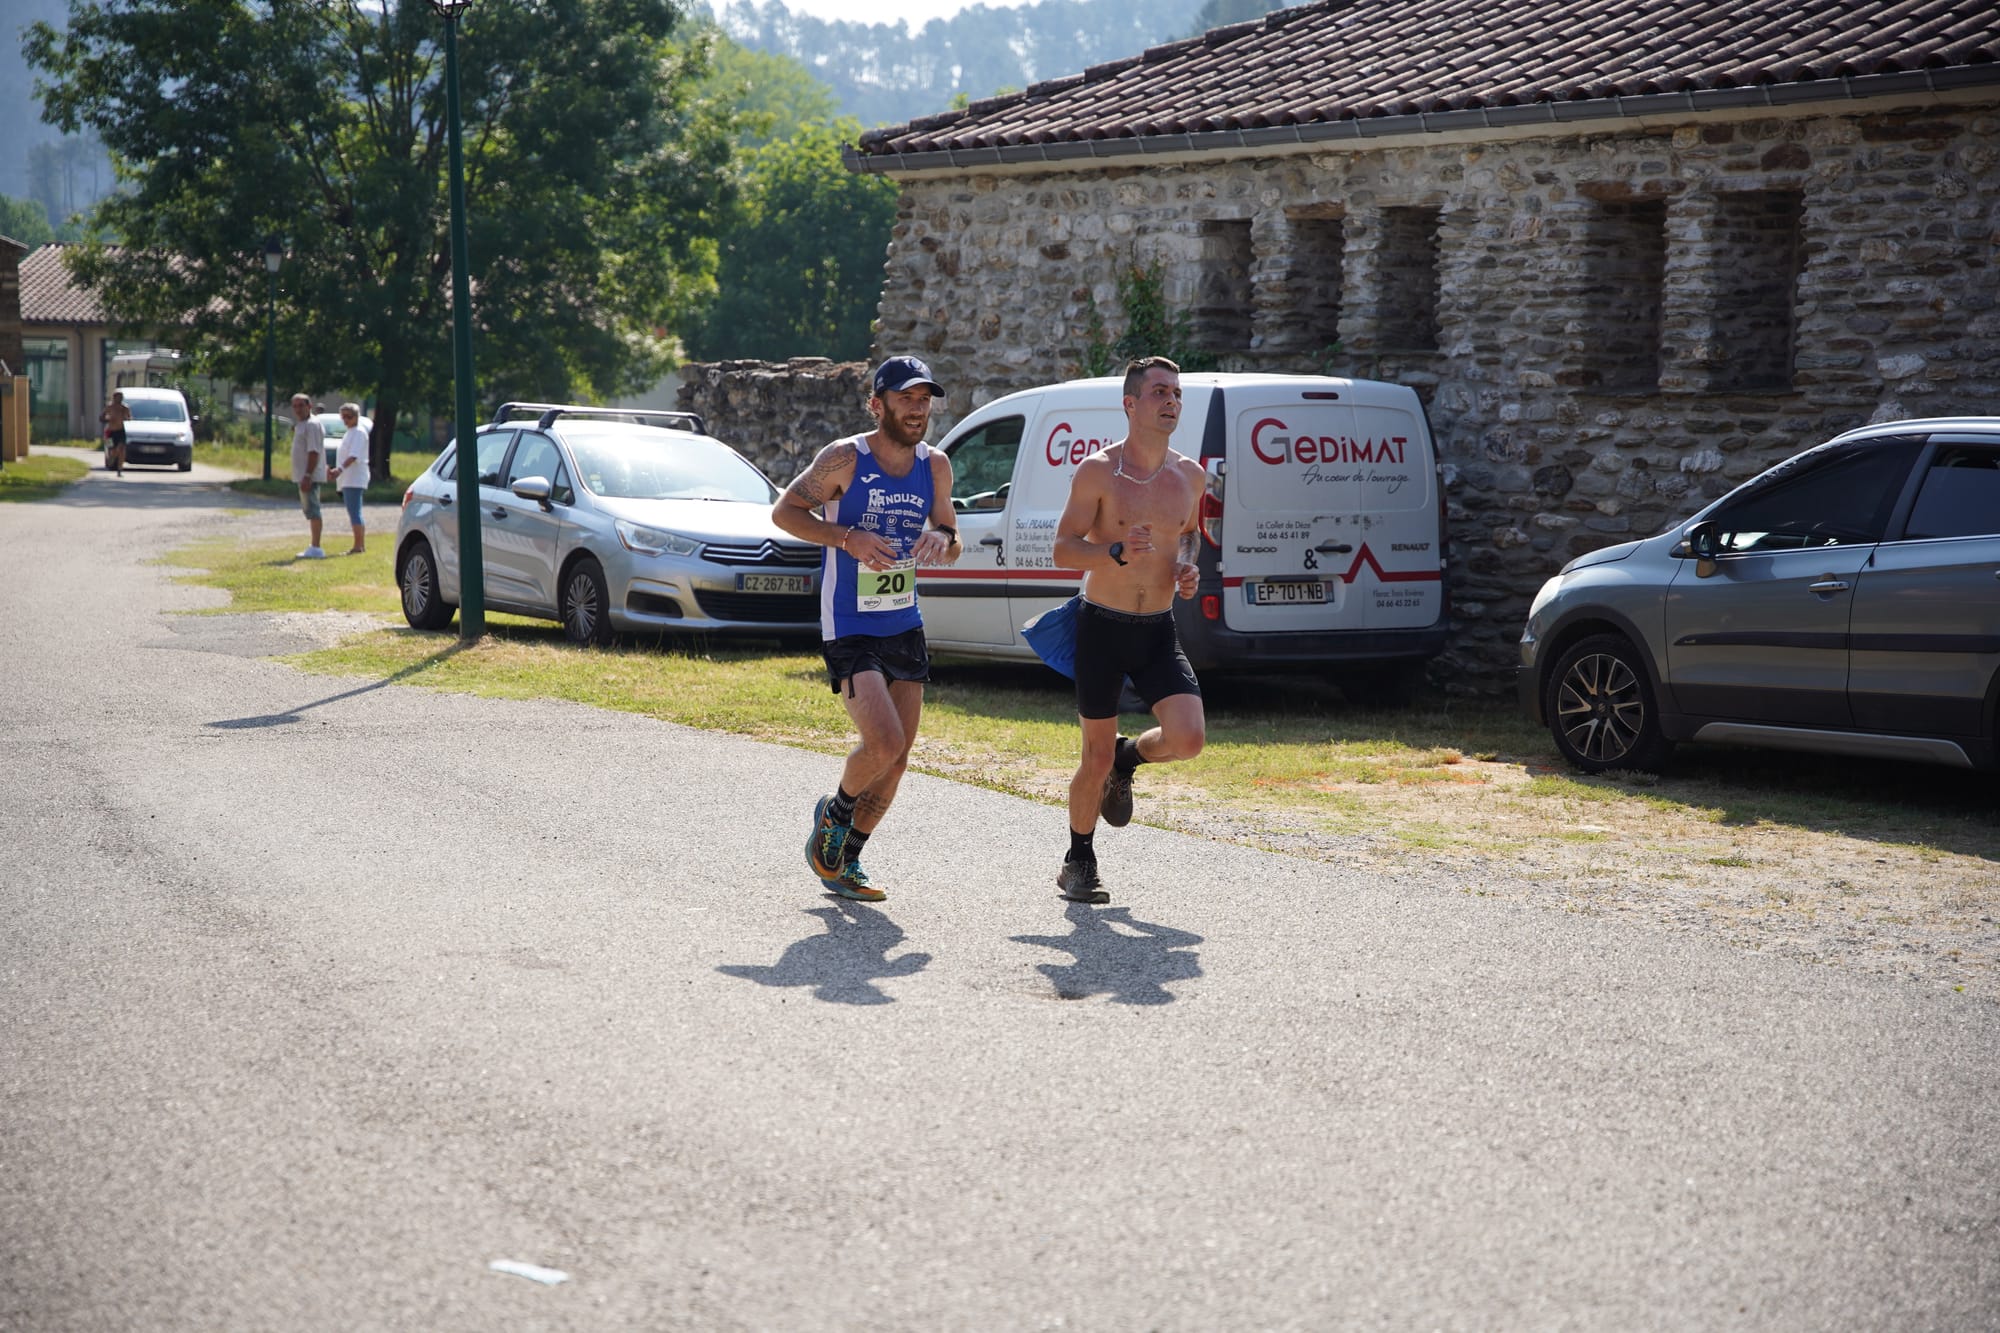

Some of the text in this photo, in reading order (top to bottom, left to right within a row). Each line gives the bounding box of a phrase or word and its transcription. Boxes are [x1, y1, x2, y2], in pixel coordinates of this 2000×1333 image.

[1353, 469, 1364, 481] de
[1257, 531, 1267, 540] 04
[1268, 531, 1278, 540] 66
[1280, 531, 1289, 540] 45
[1290, 531, 1299, 539] 41
[996, 544, 1006, 567] &
[1391, 543, 1430, 552] RENAULT
[1025, 556, 1033, 567] 66
[1035, 556, 1043, 567] 45
[1304, 549, 1319, 570] &
[745, 575, 802, 592] CZ-267-RX
[876, 573, 905, 594] 20
[1258, 584, 1324, 601] EP-701-NB
